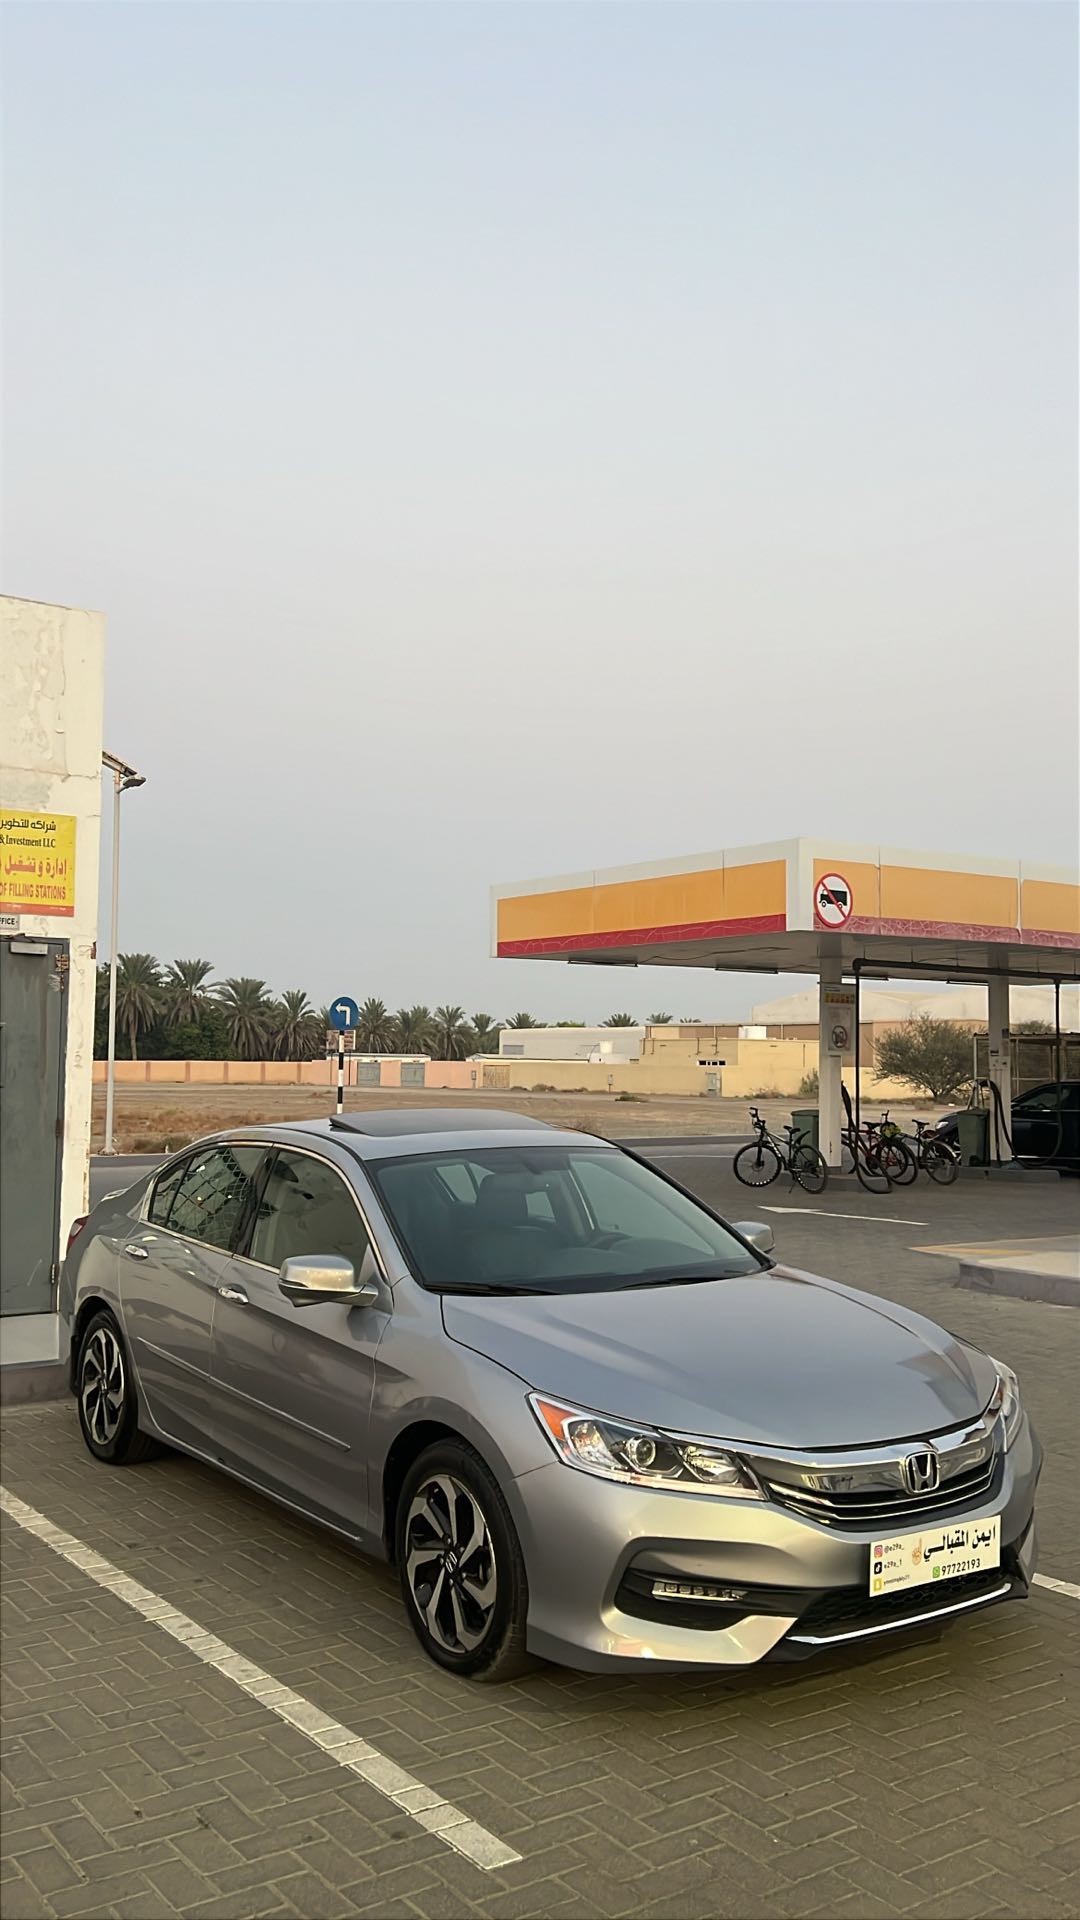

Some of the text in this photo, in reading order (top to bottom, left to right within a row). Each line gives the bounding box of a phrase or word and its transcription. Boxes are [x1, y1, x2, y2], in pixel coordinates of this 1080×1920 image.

[6, 835, 41, 847] Investment
[43, 838, 56, 848] LLC
[9, 883, 33, 898] FILLING
[35, 884, 66, 900] STATIONS
[941, 1558, 981, 1576] 97722193
